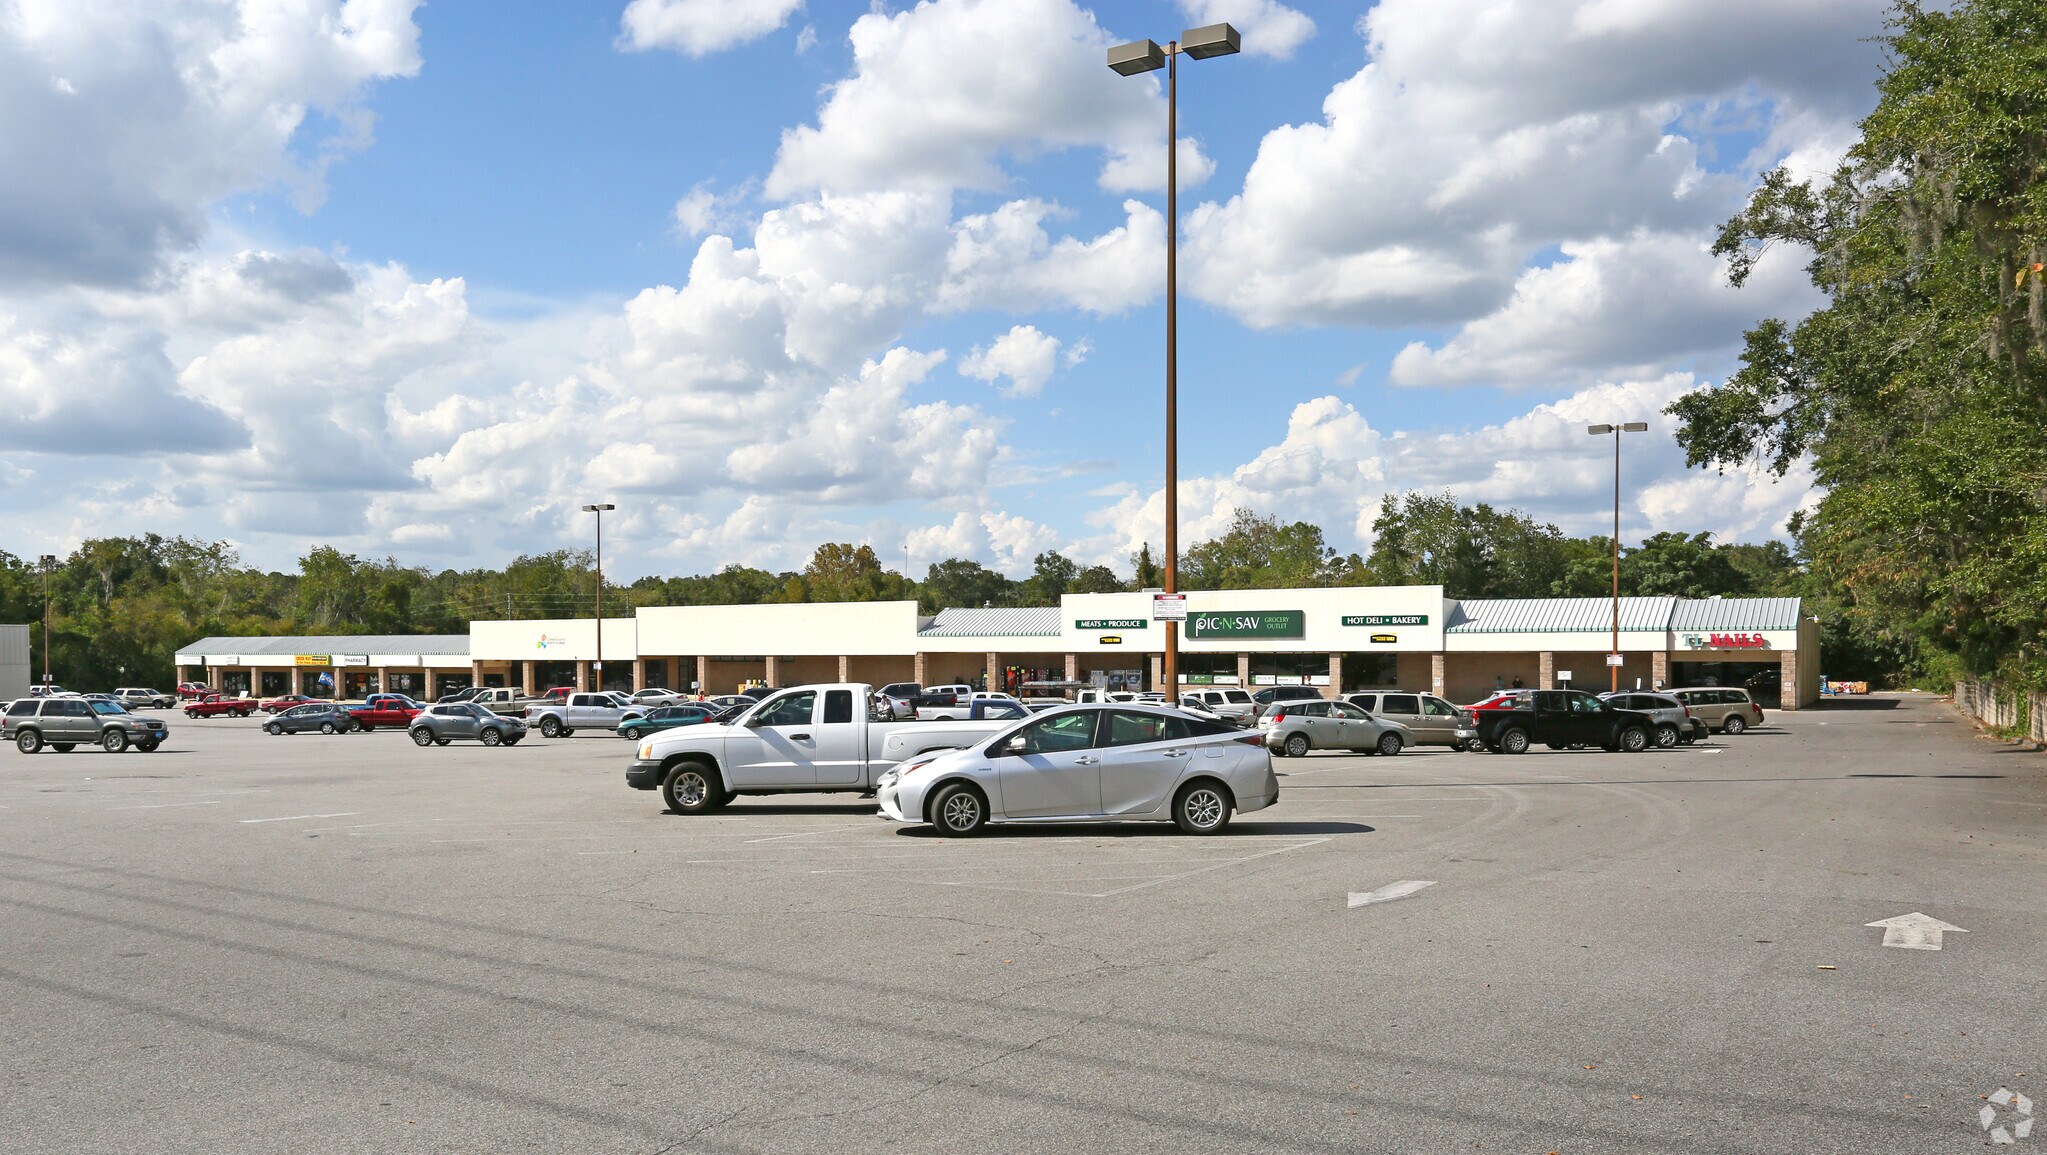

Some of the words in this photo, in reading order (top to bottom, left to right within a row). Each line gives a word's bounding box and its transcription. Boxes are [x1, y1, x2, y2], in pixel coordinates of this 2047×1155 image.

[1392, 616, 1421, 624] BAKERY
[1682, 633, 1704, 647] TL
[1709, 633, 1763, 647] NAILS
